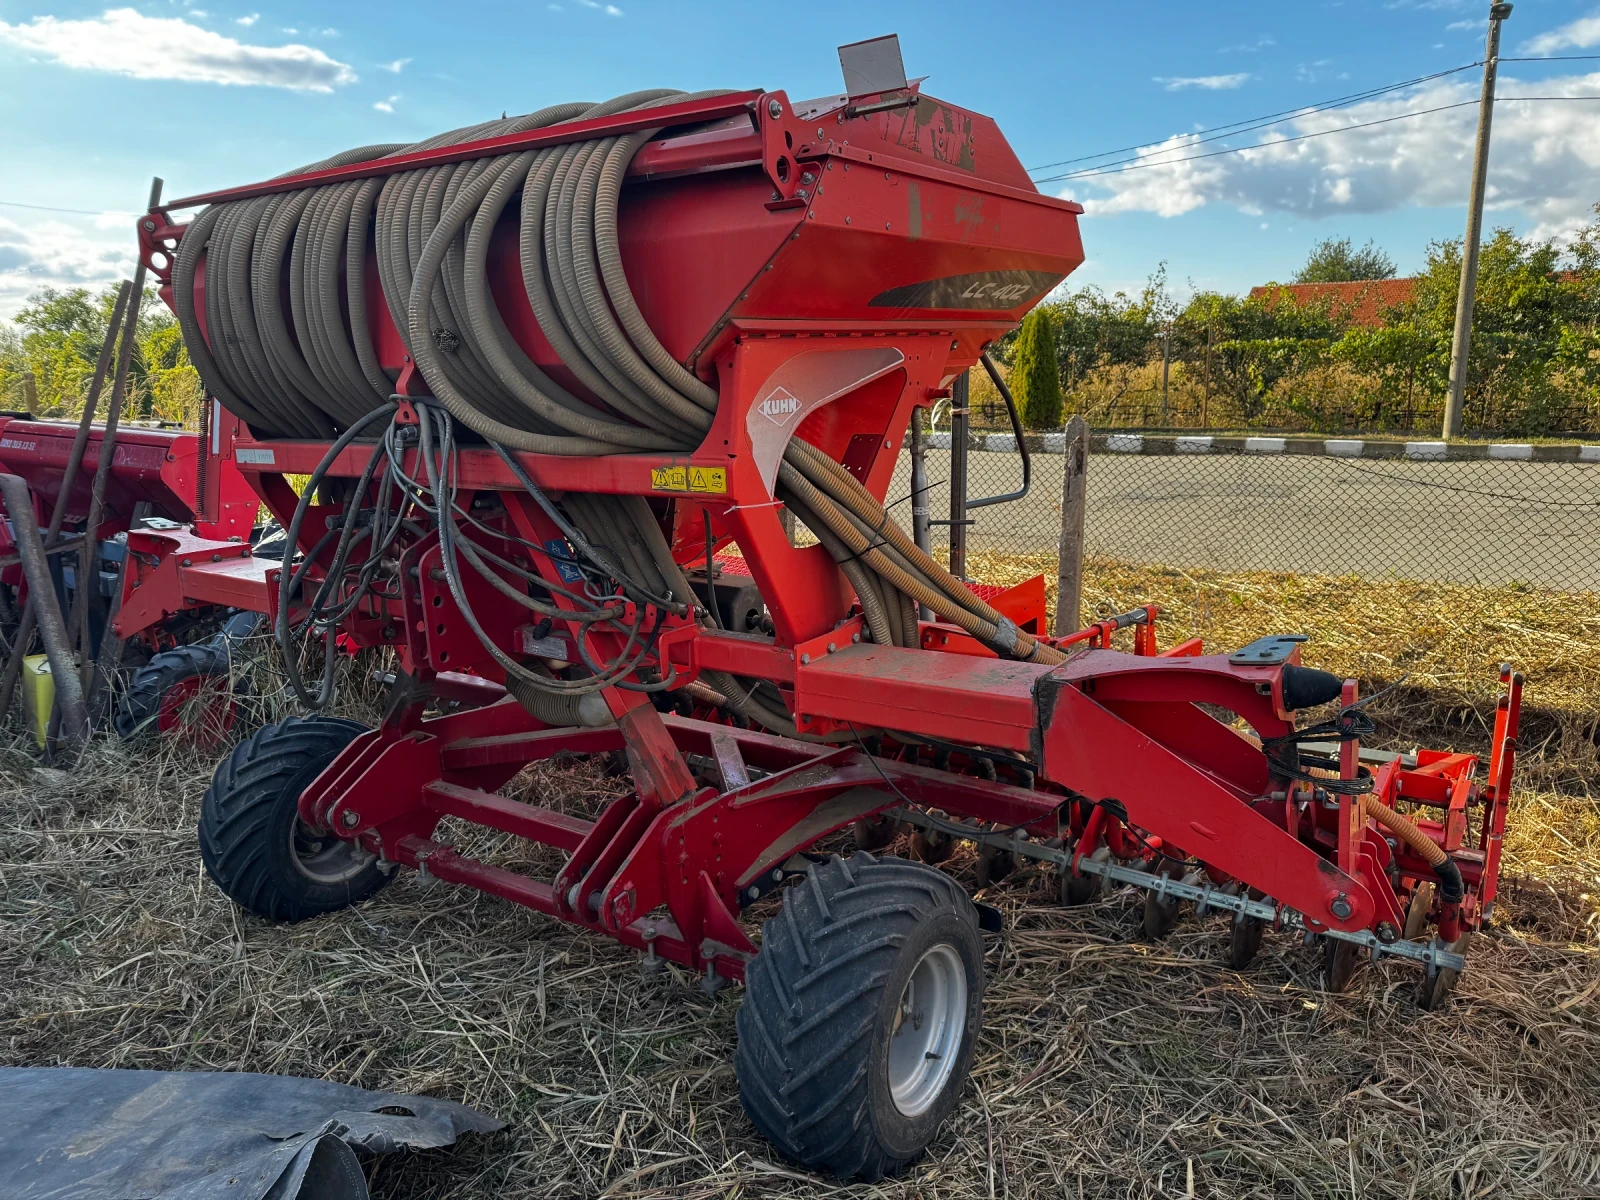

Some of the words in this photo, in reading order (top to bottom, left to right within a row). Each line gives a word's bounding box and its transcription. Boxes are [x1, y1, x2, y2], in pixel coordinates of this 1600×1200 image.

[961, 281, 998, 299] LC
[991, 283, 1031, 300] 402
[763, 398, 797, 416] KUHN
